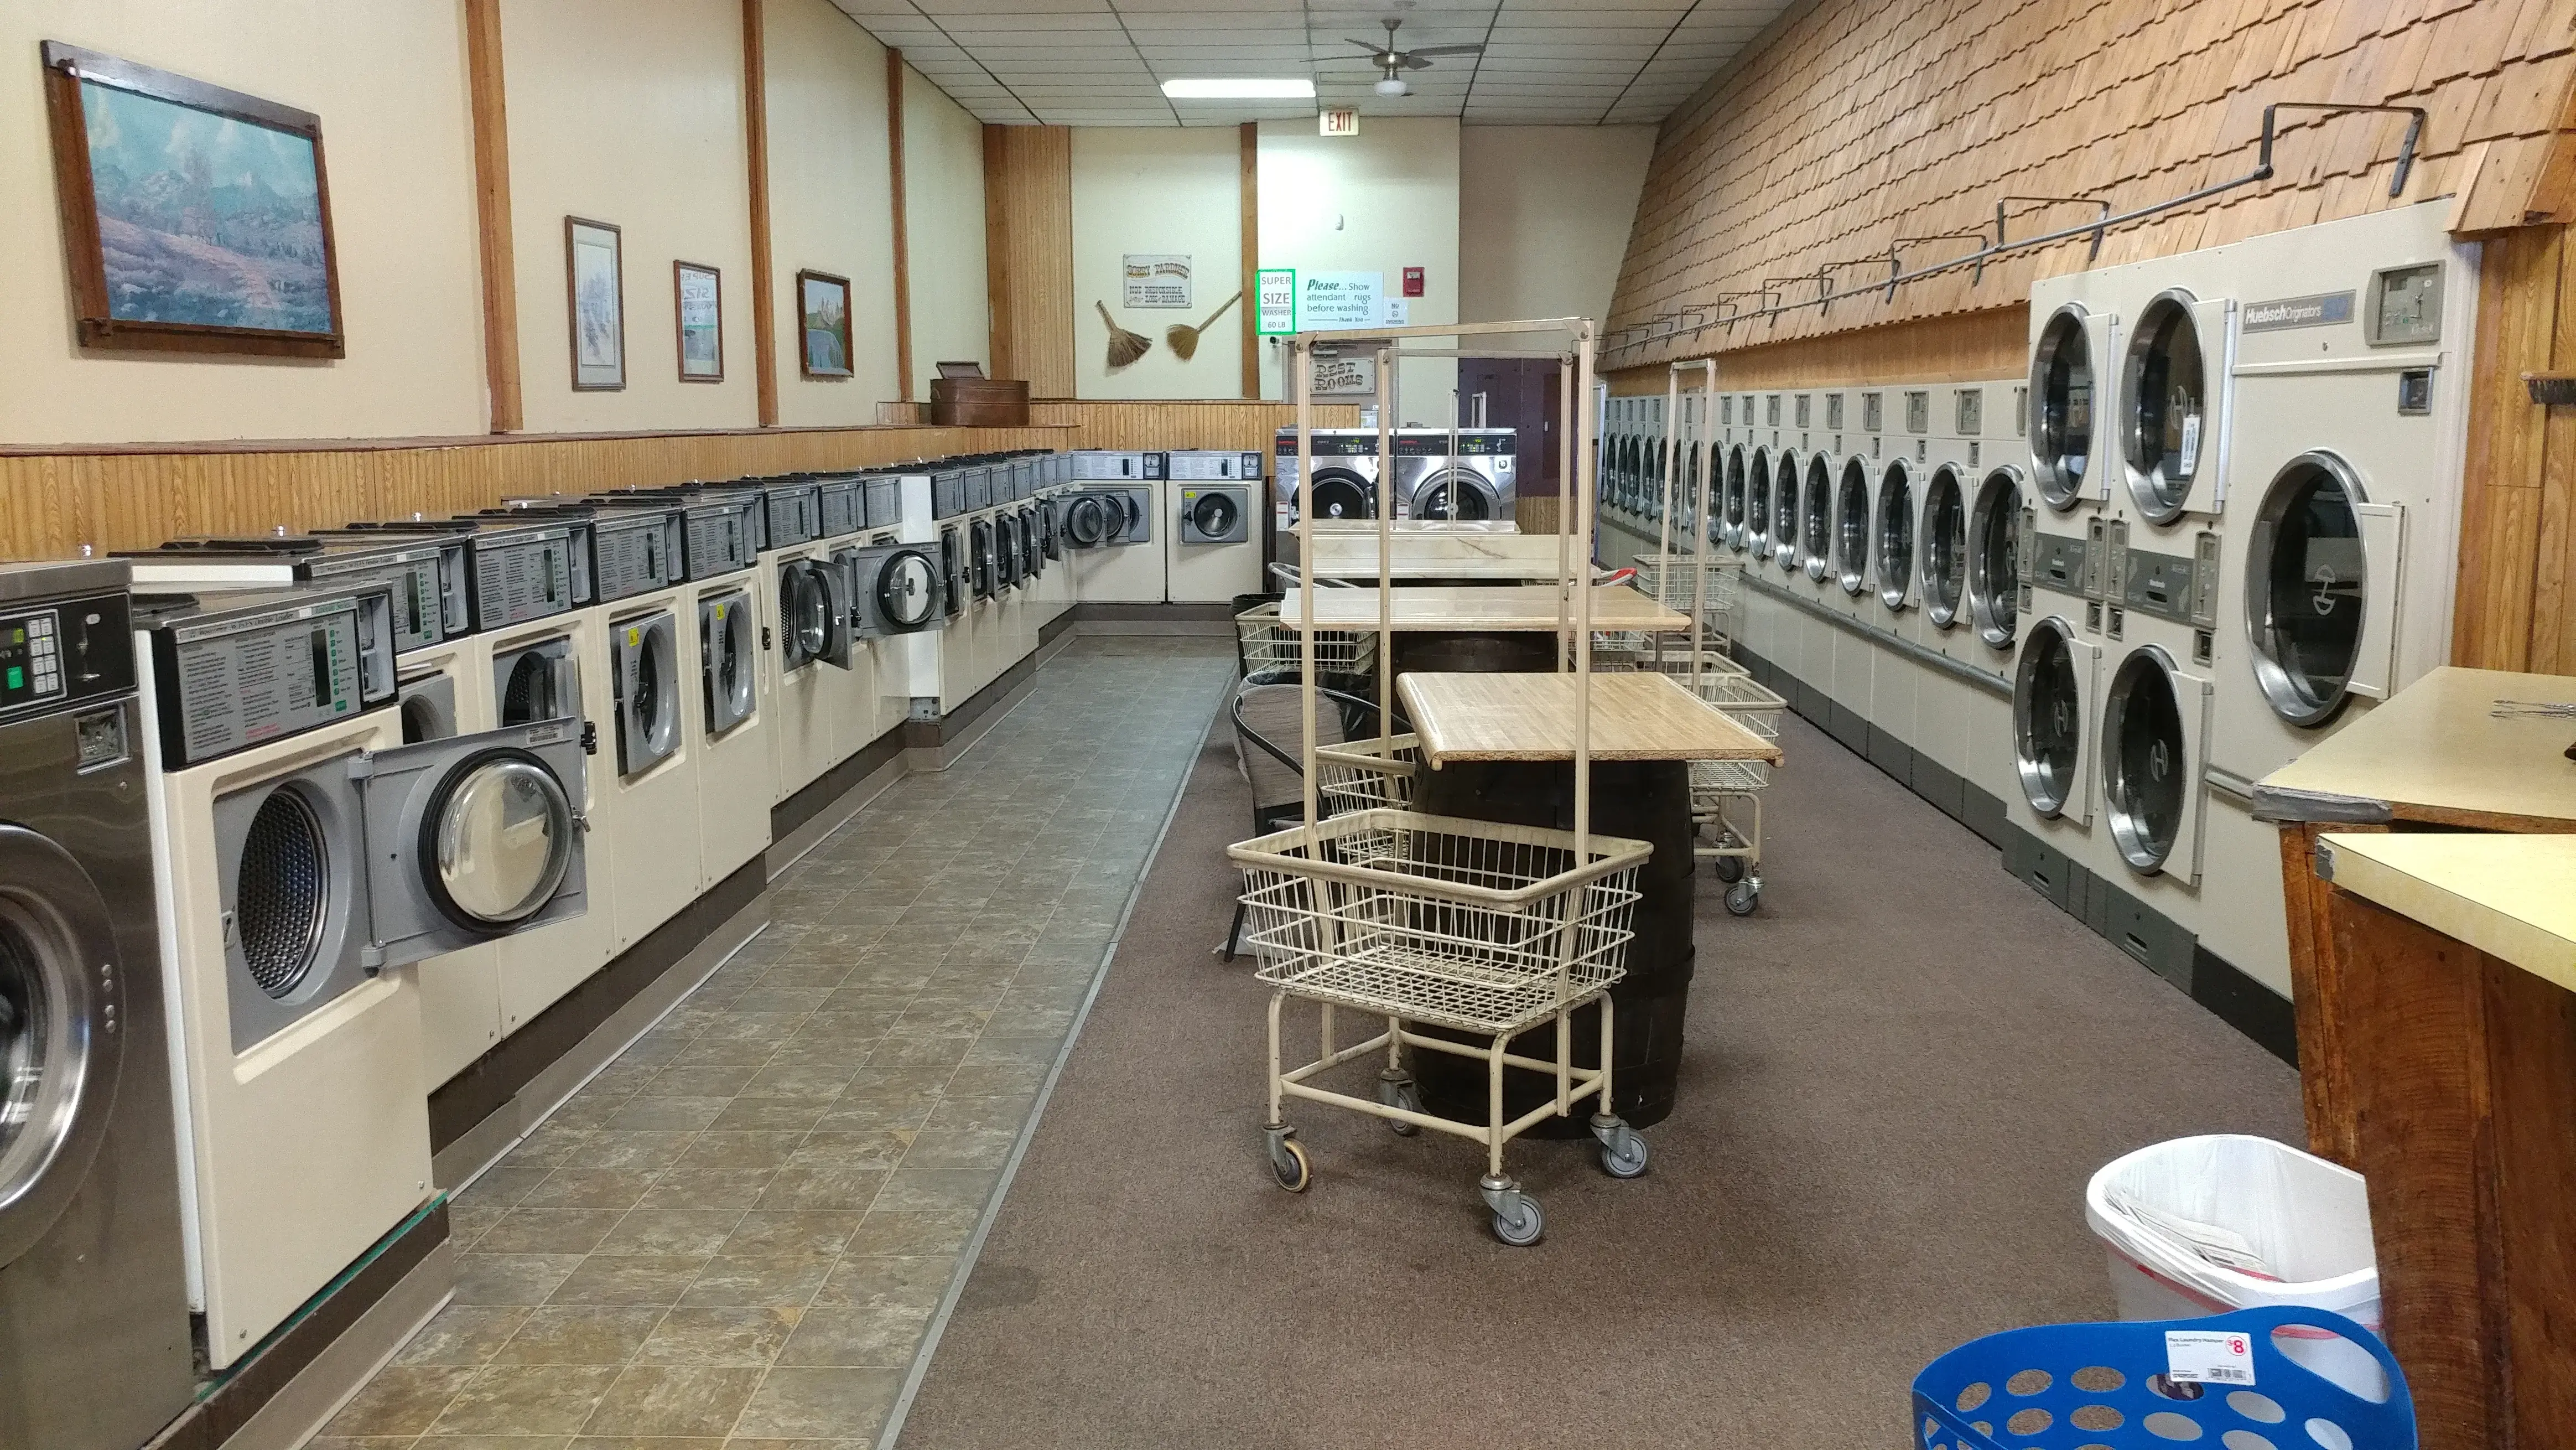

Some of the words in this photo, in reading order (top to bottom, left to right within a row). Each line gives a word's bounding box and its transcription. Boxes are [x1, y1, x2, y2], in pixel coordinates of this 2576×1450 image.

[1328, 112, 1352, 131] EXIT
[1263, 293, 1290, 304] SIZE
[1354, 294, 1371, 304] rugs
[1337, 304, 1370, 315] washing.
[2245, 304, 2286, 324] Huebsch
[1315, 362, 1355, 377] REST
[1314, 375, 1363, 391] ROOMS
